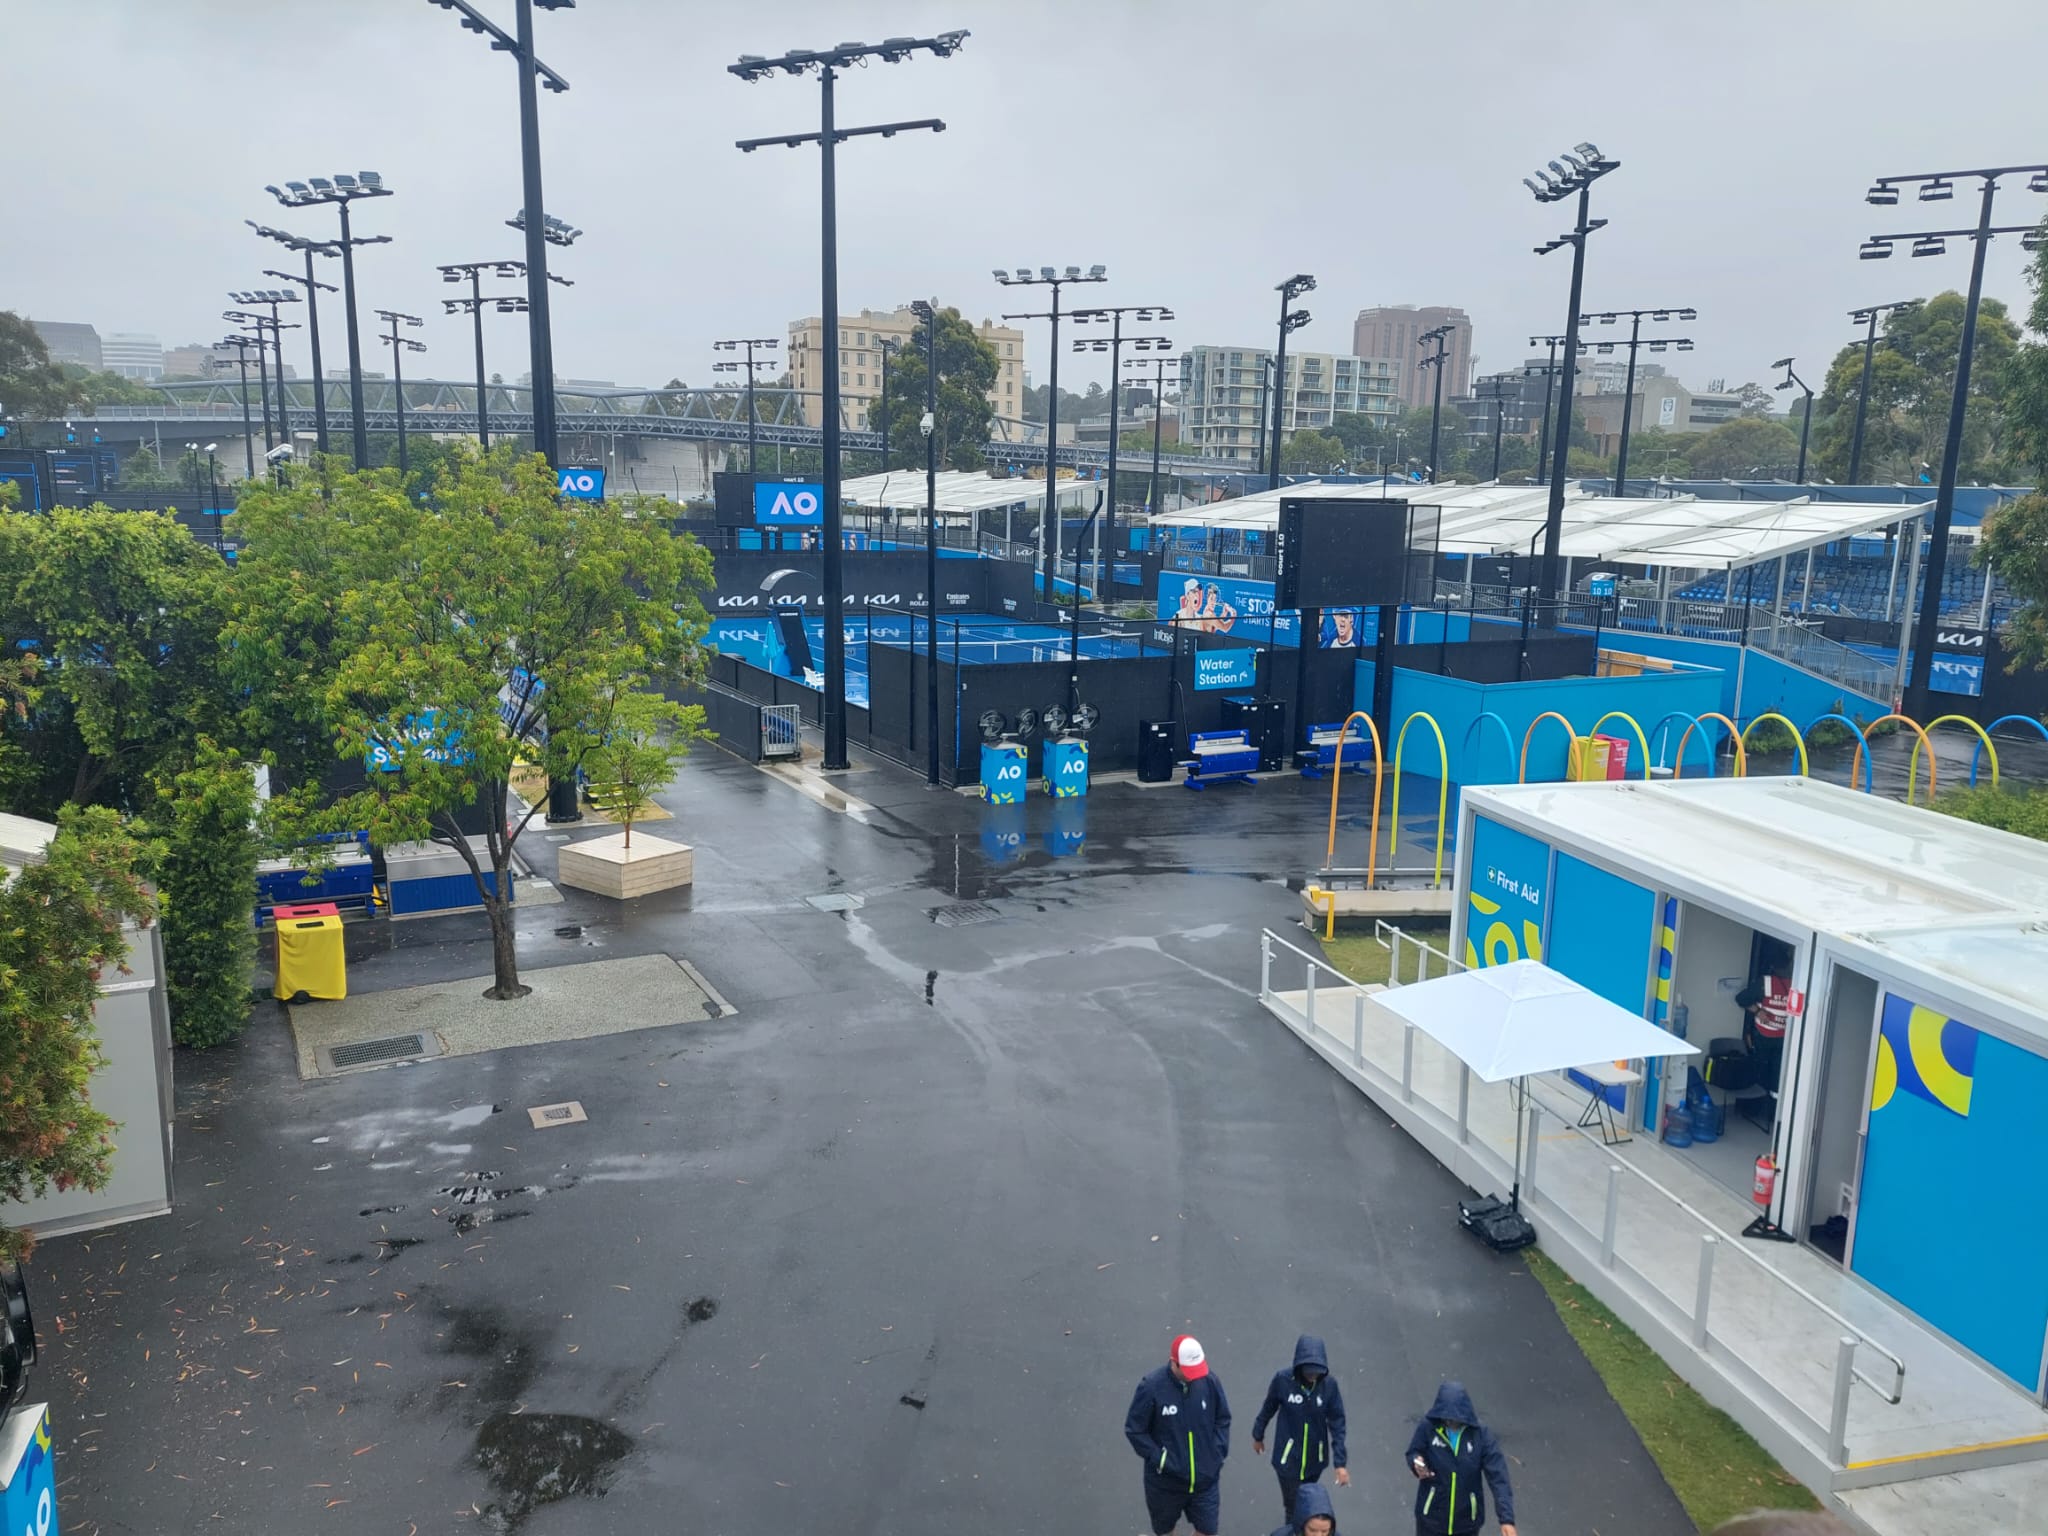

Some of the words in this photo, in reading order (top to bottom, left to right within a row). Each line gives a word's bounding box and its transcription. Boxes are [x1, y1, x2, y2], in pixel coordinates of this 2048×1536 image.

[561, 475, 594, 491] AO
[770, 491, 817, 515] AO
[1278, 533, 1285, 547] 10
[1235, 597, 1248, 607] THE
[1200, 659, 1234, 671] Water
[1199, 673, 1238, 685] Station
[997, 765, 1021, 780] AO
[1062, 760, 1085, 774] AO
[1497, 870, 1519, 895] First
[1521, 883, 1540, 905] Aid
[1288, 1394, 1304, 1404] AO
[1162, 1404, 1178, 1416] AO
[26, 1487, 51, 1536] O
